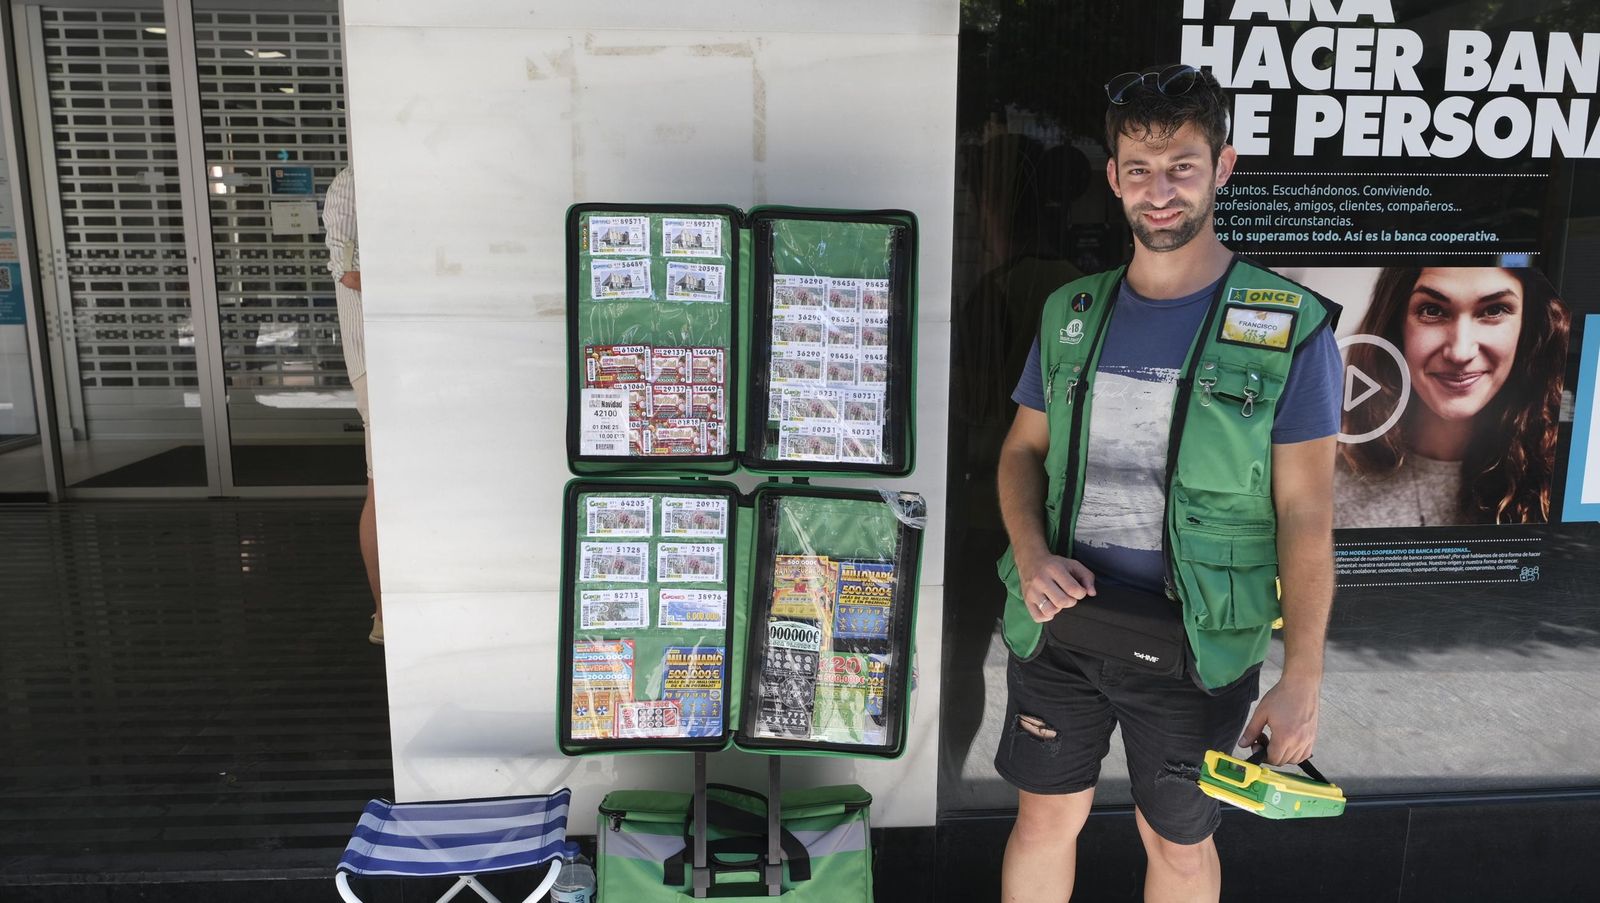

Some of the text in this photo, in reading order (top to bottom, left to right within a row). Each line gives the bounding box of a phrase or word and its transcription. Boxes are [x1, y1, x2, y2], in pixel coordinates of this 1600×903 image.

[1181, 25, 1423, 90] HACER
[1226, 94, 1600, 159] E PERSON
[1231, 184, 1270, 198] juntos.
[1272, 184, 1360, 196] Escuchándonos.
[1363, 185, 1432, 196] Conviviendo.
[1294, 200, 1336, 213] amigos,
[1339, 200, 1384, 213] clientes,
[1387, 201, 1462, 214] compañeros...
[1230, 215, 1252, 227] Con
[1254, 215, 1272, 226] mil
[1274, 215, 1354, 227] circunstancias.
[1232, 230, 1243, 241] lo
[1246, 231, 1309, 243] superamos
[1312, 231, 1341, 241] todo.
[1344, 230, 1363, 241] Así
[1365, 232, 1378, 241] es
[1381, 230, 1391, 241] la
[1394, 230, 1427, 241] banca
[1430, 230, 1500, 243] cooperativa.
[1249, 292, 1296, 303] ONCE
[1239, 320, 1278, 331] FRANCISCO
[601, 400, 623, 408] Navidad
